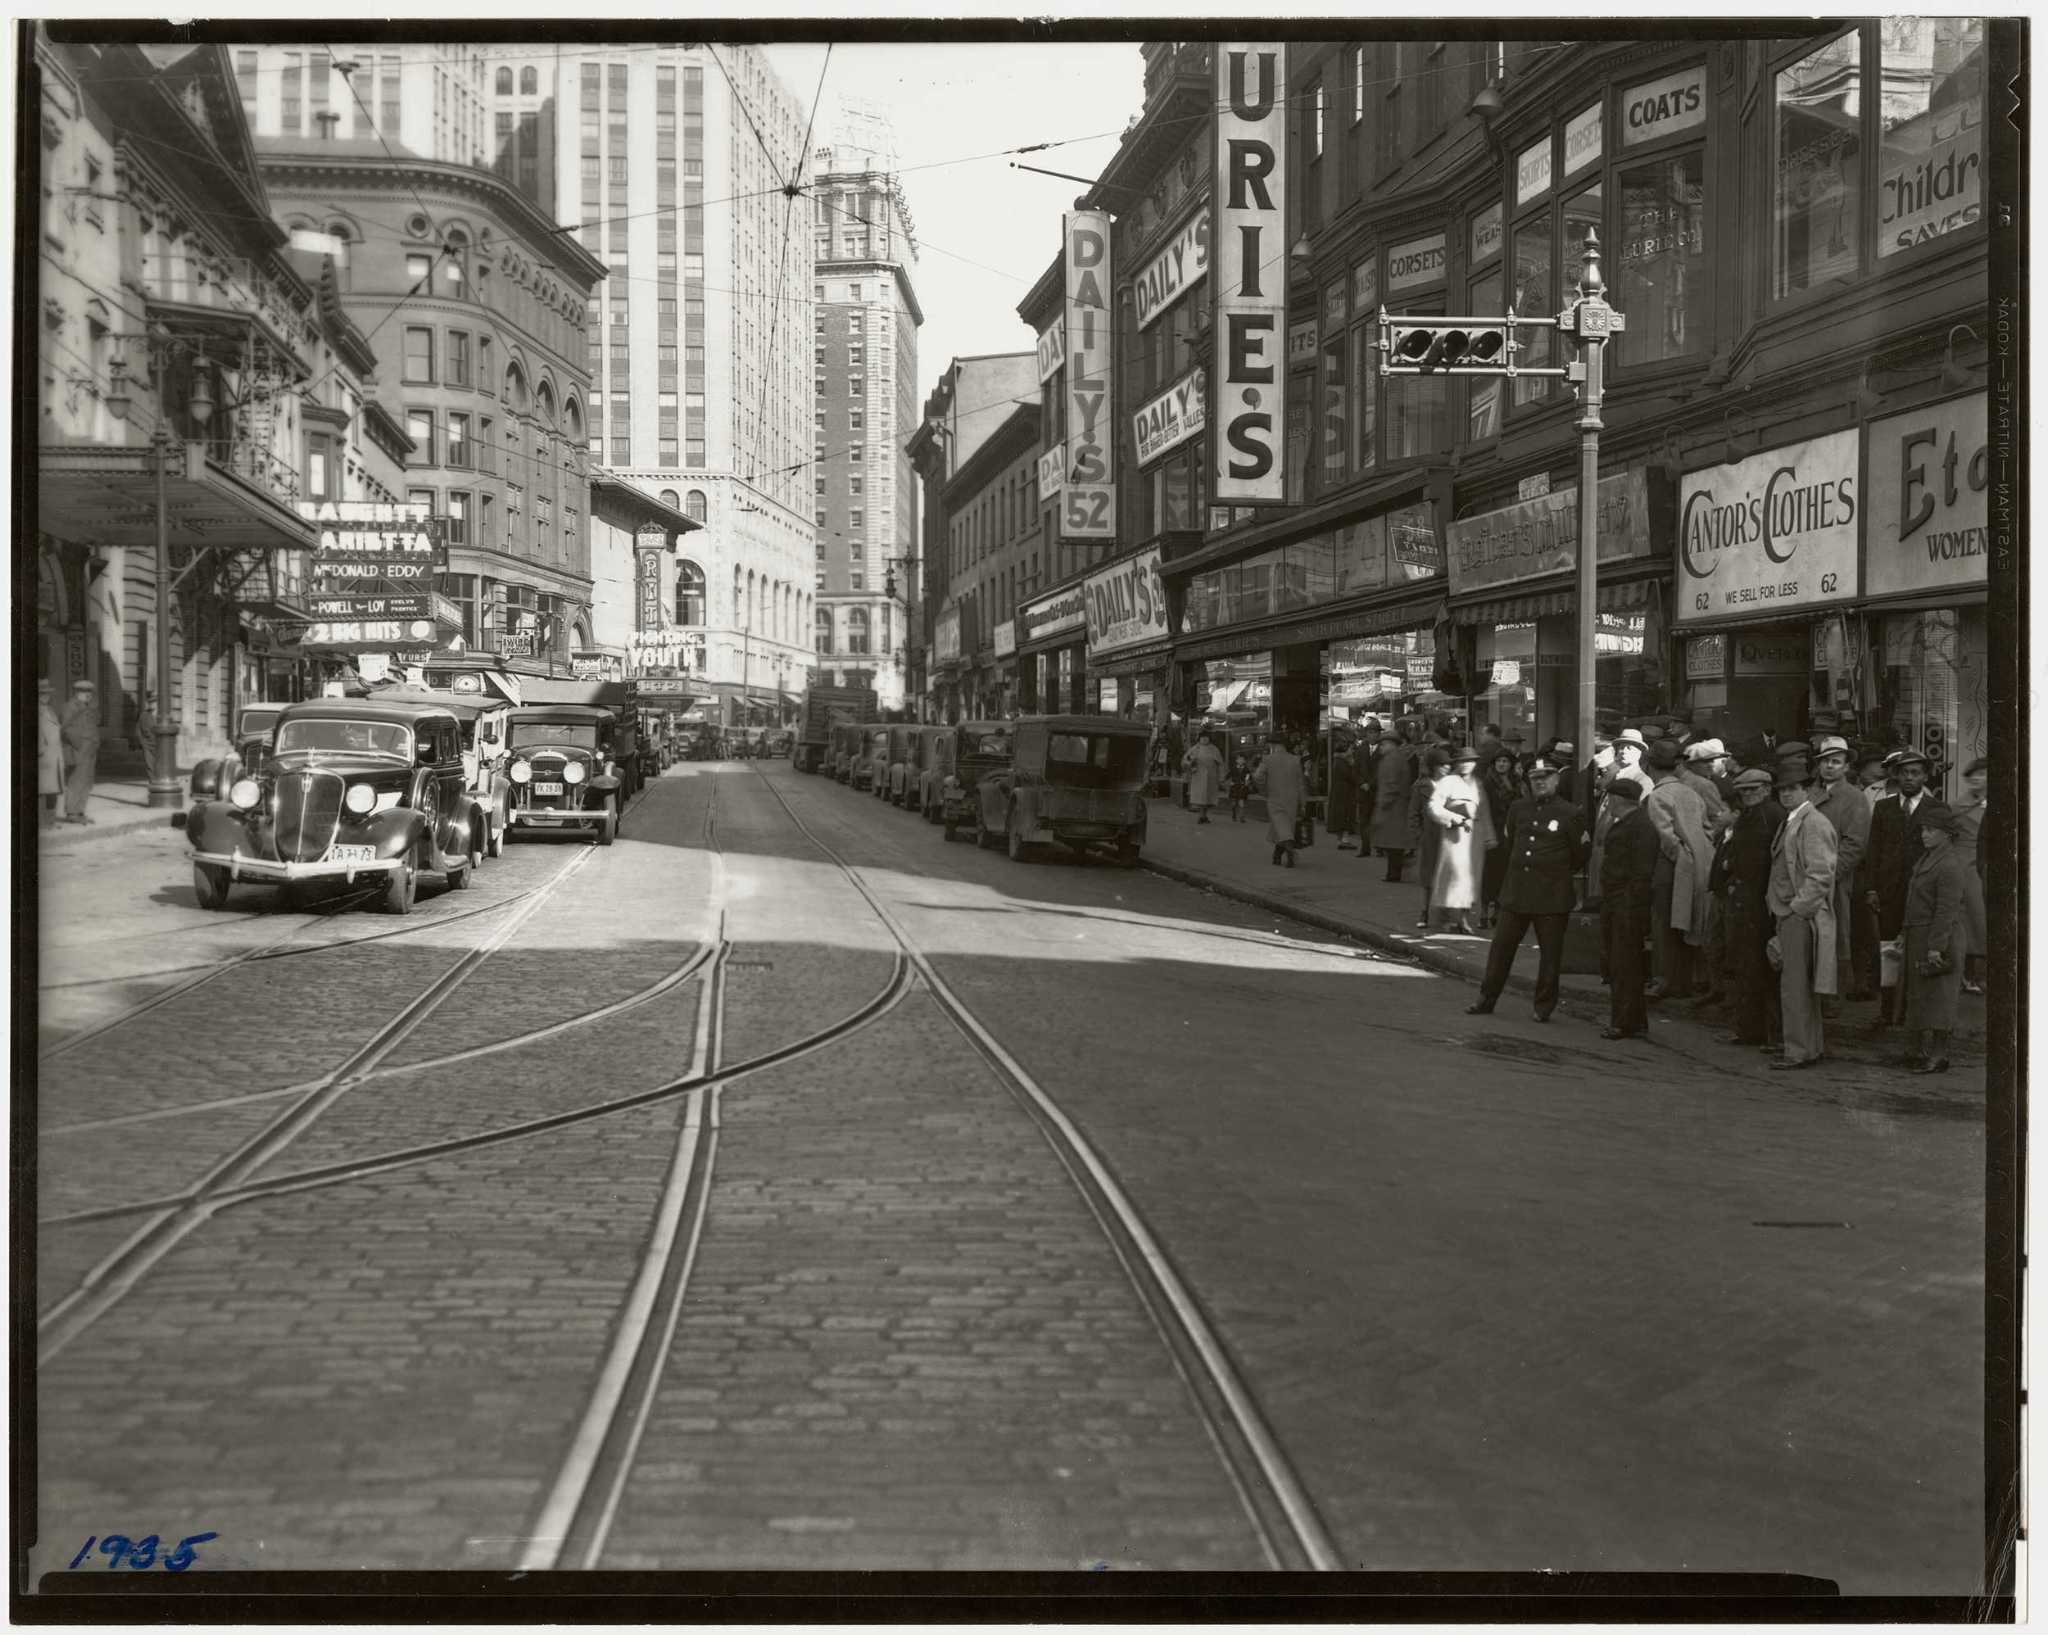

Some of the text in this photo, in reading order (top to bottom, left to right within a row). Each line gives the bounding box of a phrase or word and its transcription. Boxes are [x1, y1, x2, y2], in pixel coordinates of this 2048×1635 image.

[1629, 84, 1700, 128] COATS
[1137, 215, 1209, 322] DAILY'S
[1390, 246, 1446, 279] CORSETS
[1073, 229, 1106, 482] DAILY'S
[1136, 371, 1206, 445] DAILY'S
[1067, 491, 1110, 529] 52
[1681, 489, 1761, 578] CANTOR'S
[1762, 466, 1855, 563] CLOTHES
[387, 564, 425, 578] EDDY
[318, 600, 385, 614] POWELL LOY
[1094, 558, 1151, 638] DAILY'S
[1696, 572, 1837, 610] 62 WE SELL FOR LESS 62
[313, 622, 330, 642] 2
[332, 622, 362, 641] BIG
[365, 621, 401, 640] HITS
[629, 647, 698, 667] YOUTH
